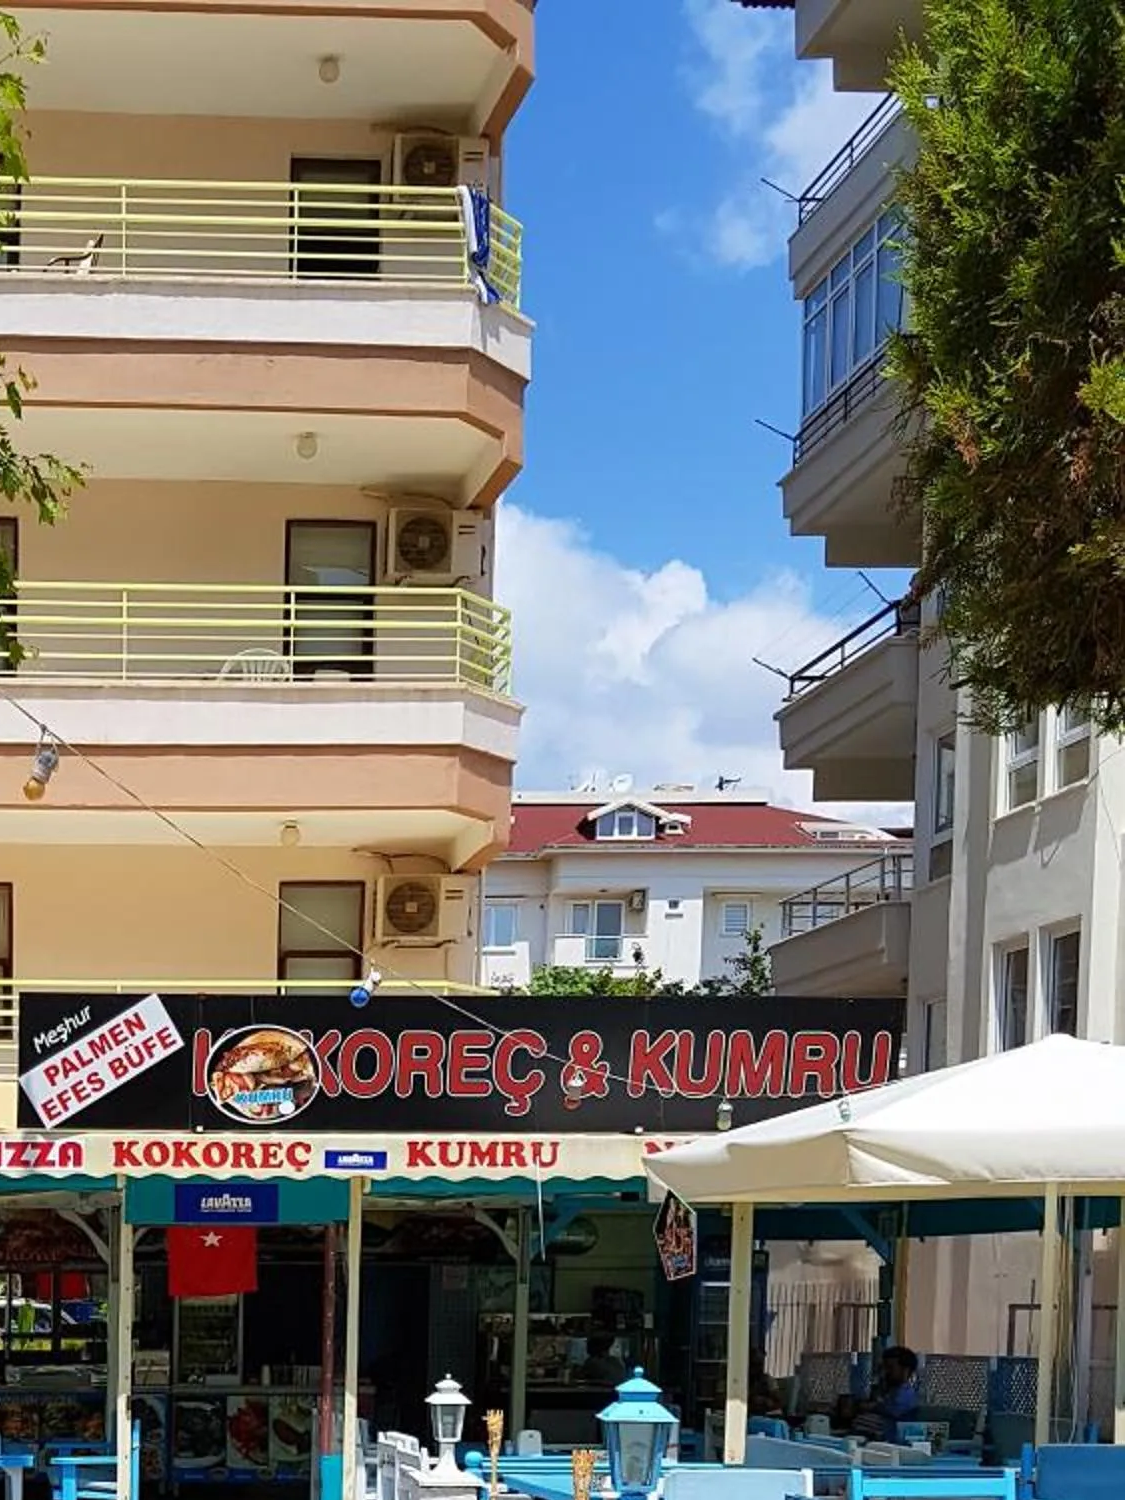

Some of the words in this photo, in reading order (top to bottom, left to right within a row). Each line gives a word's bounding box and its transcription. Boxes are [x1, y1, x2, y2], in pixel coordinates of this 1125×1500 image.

[41, 1071, 106, 1122] EFES
[110, 1026, 177, 1082] BÜFE
[42, 1012, 147, 1087] PALMEN
[562, 1030, 610, 1099] &
[627, 1028, 892, 1099] KUMRU
[112, 1140, 312, 1172] KOKOREÇ
[406, 1140, 560, 1168] KUMRU
